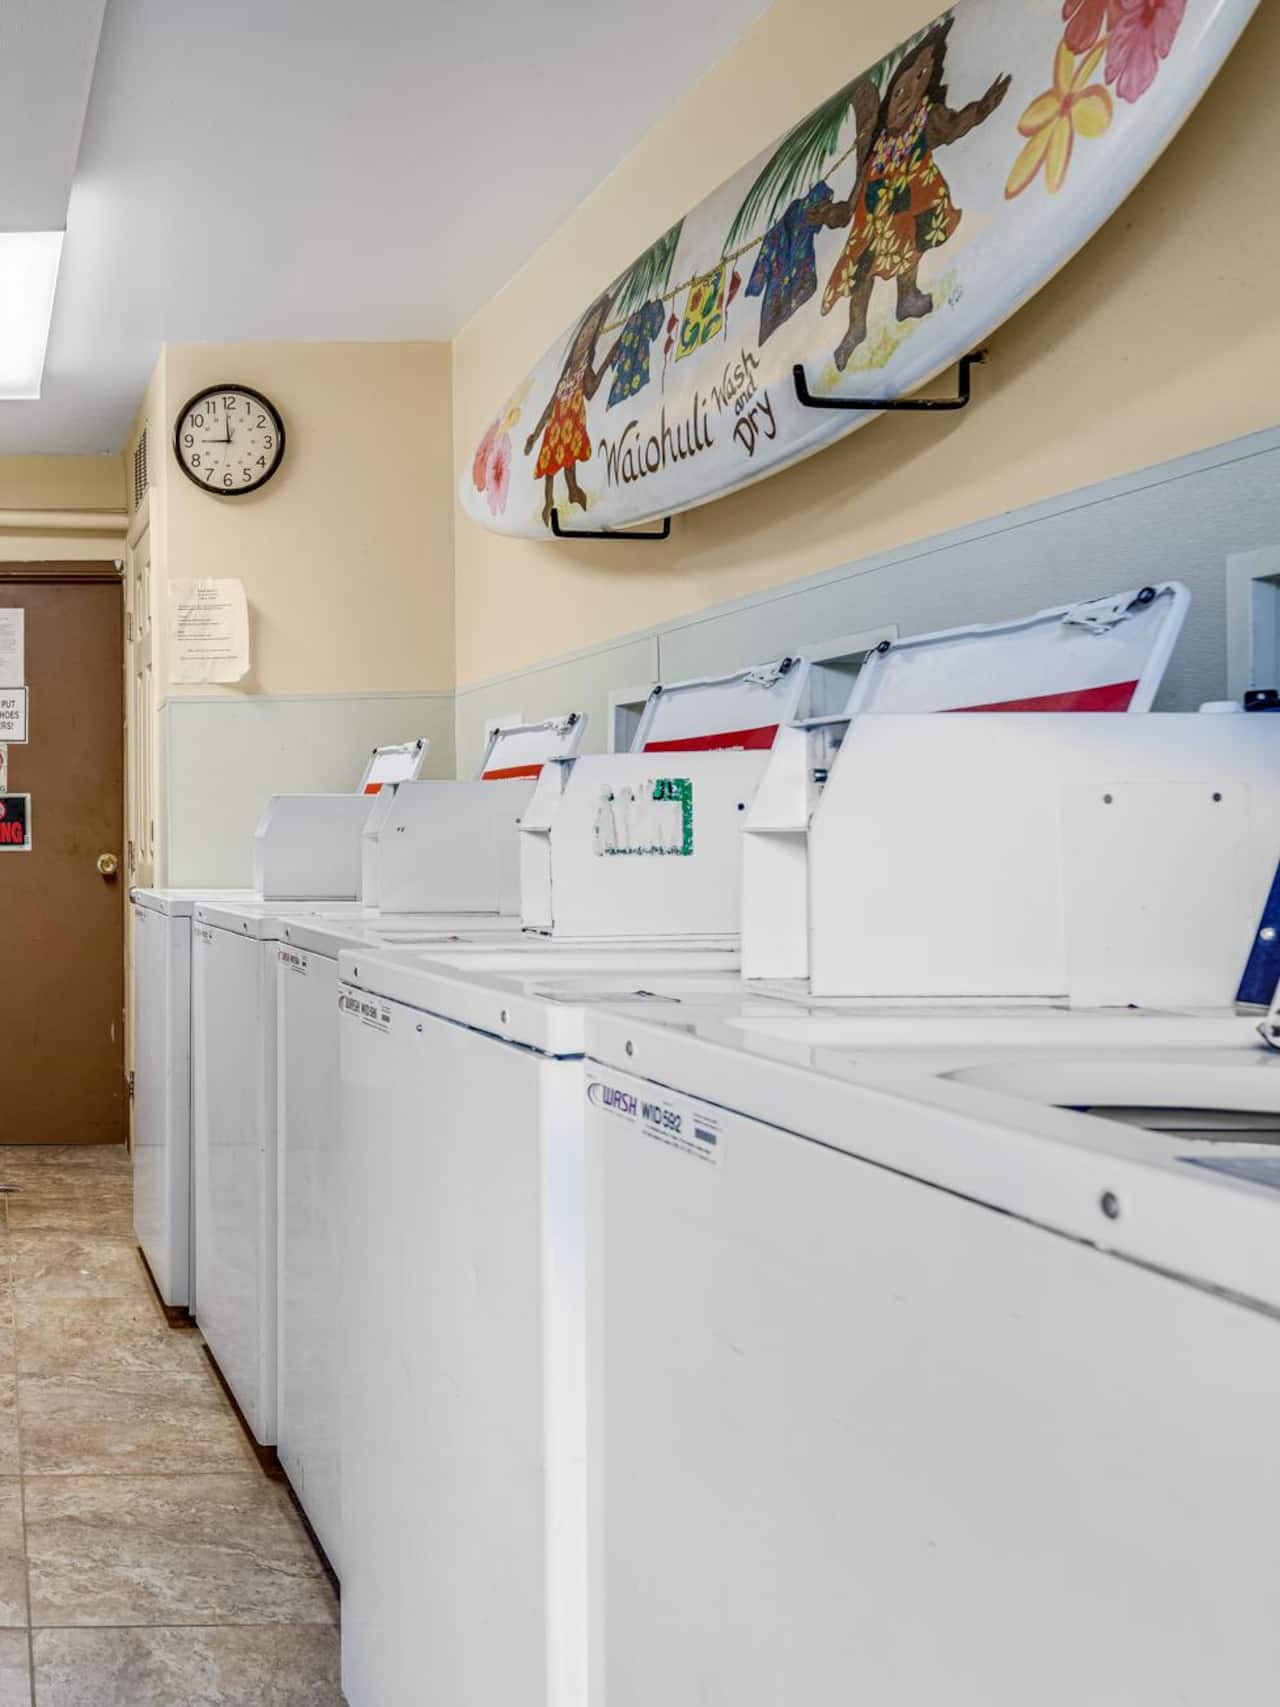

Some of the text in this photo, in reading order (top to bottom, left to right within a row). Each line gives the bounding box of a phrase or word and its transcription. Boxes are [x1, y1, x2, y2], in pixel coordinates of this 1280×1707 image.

[711, 348, 760, 415] Wash
[222, 396, 236, 410] 12
[734, 379, 757, 416] and
[205, 400, 216, 414] 11
[245, 402, 251, 415] 1
[190, 414, 204, 428] 10
[256, 415, 266, 429] 2
[733, 391, 777, 457] Dry
[184, 434, 194, 448] 9
[263, 435, 272, 449] 3
[598, 391, 714, 488] Waiohuli
[191, 453, 200, 467] 8
[256, 455, 266, 468] 4
[205, 468, 215, 481] 7
[223, 472, 232, 487] 6
[242, 468, 252, 482] 5
[1, 699, 16, 709] PUT
[602, 1084, 638, 1116] WASH
